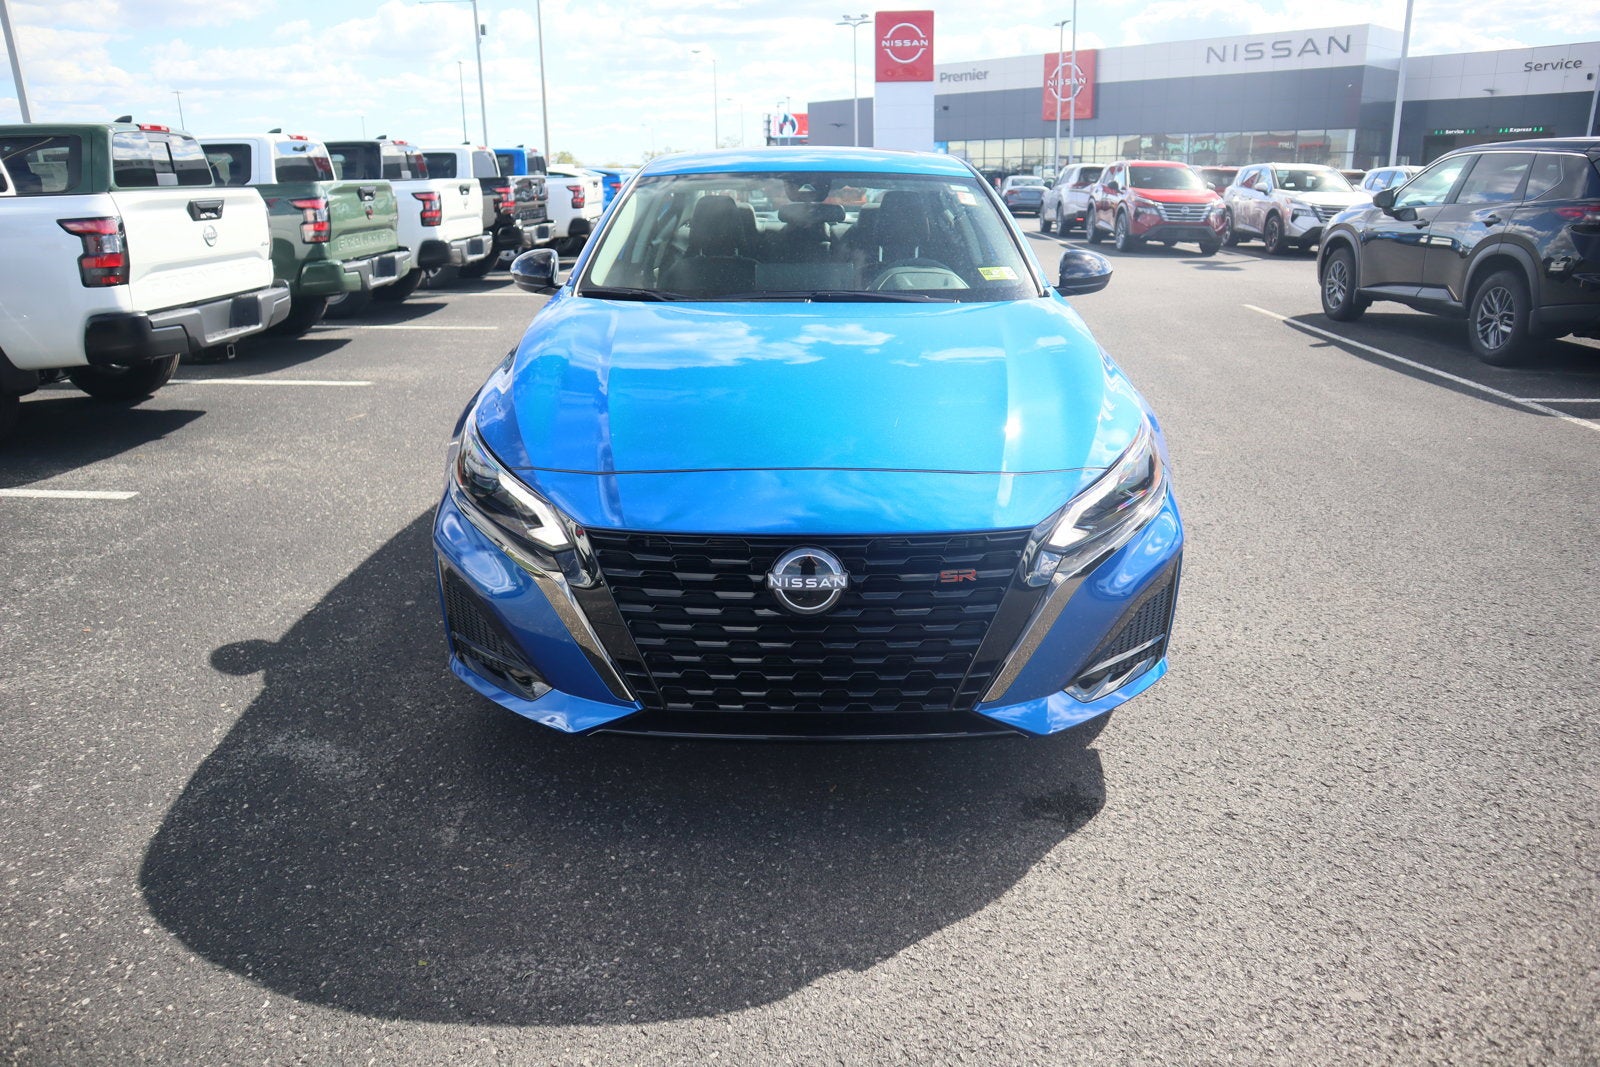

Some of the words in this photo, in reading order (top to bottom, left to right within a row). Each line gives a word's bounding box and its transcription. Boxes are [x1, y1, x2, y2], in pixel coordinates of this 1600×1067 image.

[881, 39, 928, 47] NISSAN
[1205, 34, 1352, 64] NISSAN
[1523, 57, 1583, 73] Service
[939, 68, 990, 83] Premier
[769, 575, 846, 589] NISSAN
[940, 568, 977, 583] SR
